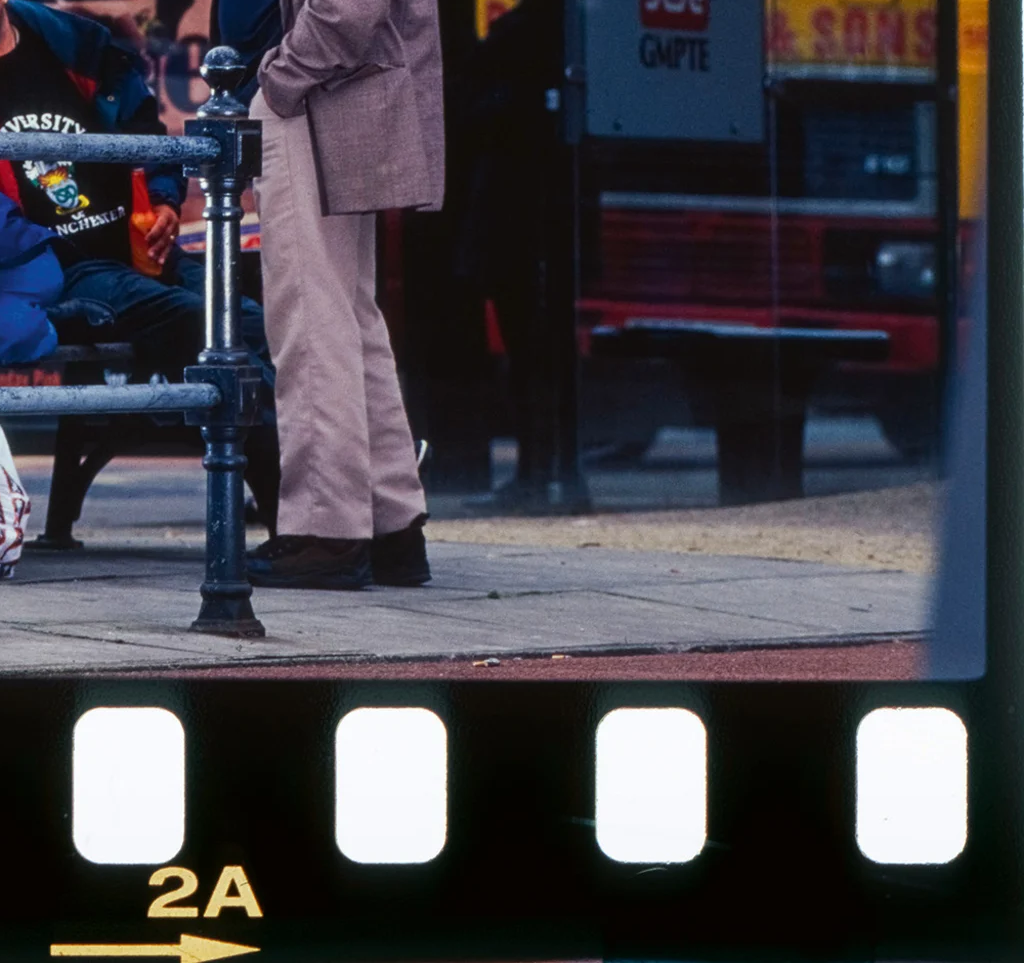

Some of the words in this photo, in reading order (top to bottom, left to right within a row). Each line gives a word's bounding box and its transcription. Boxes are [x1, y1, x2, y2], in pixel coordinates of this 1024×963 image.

[638, 32, 710, 72] GMPTE
[811, 6, 937, 63] SONS
[147, 865, 264, 918] 2A
